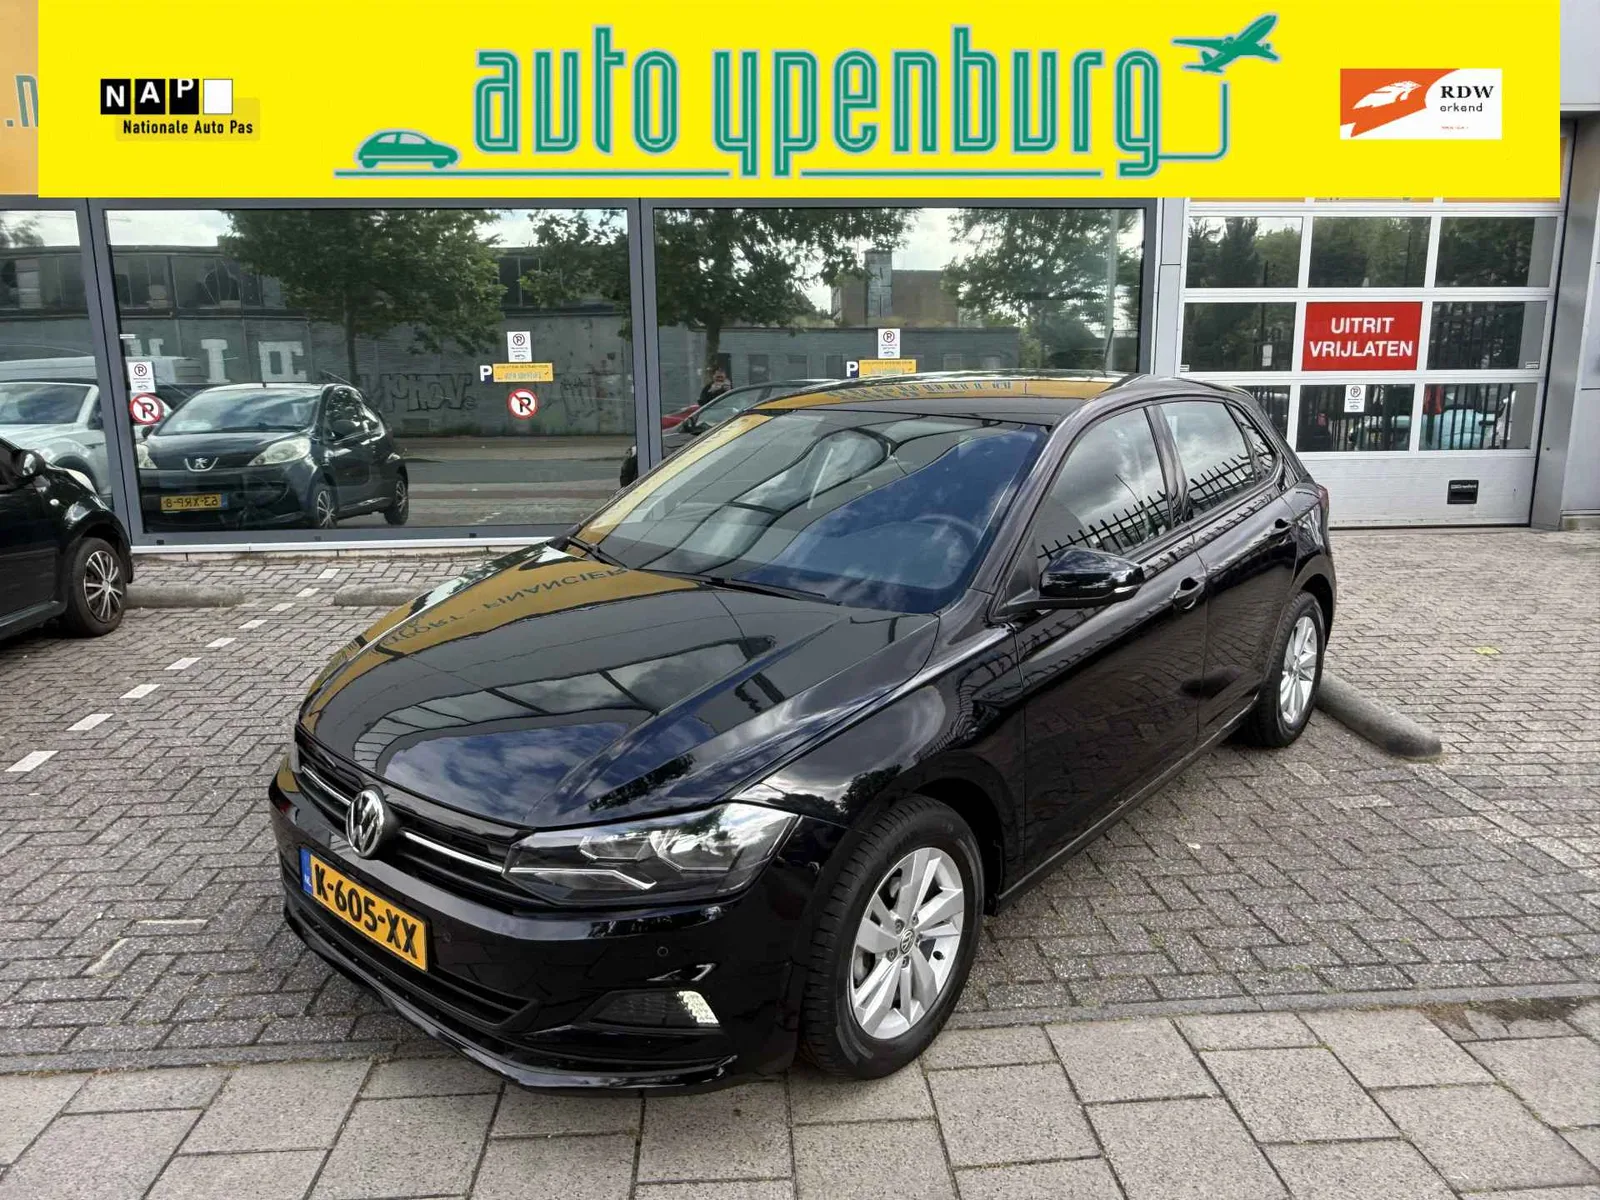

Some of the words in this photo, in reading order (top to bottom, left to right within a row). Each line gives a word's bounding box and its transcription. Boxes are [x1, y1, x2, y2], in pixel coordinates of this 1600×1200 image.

[1330, 317, 1395, 334] UITRIT
[1309, 340, 1413, 357] VRIJLATEN
[314, 863, 418, 960] K-605-XX
